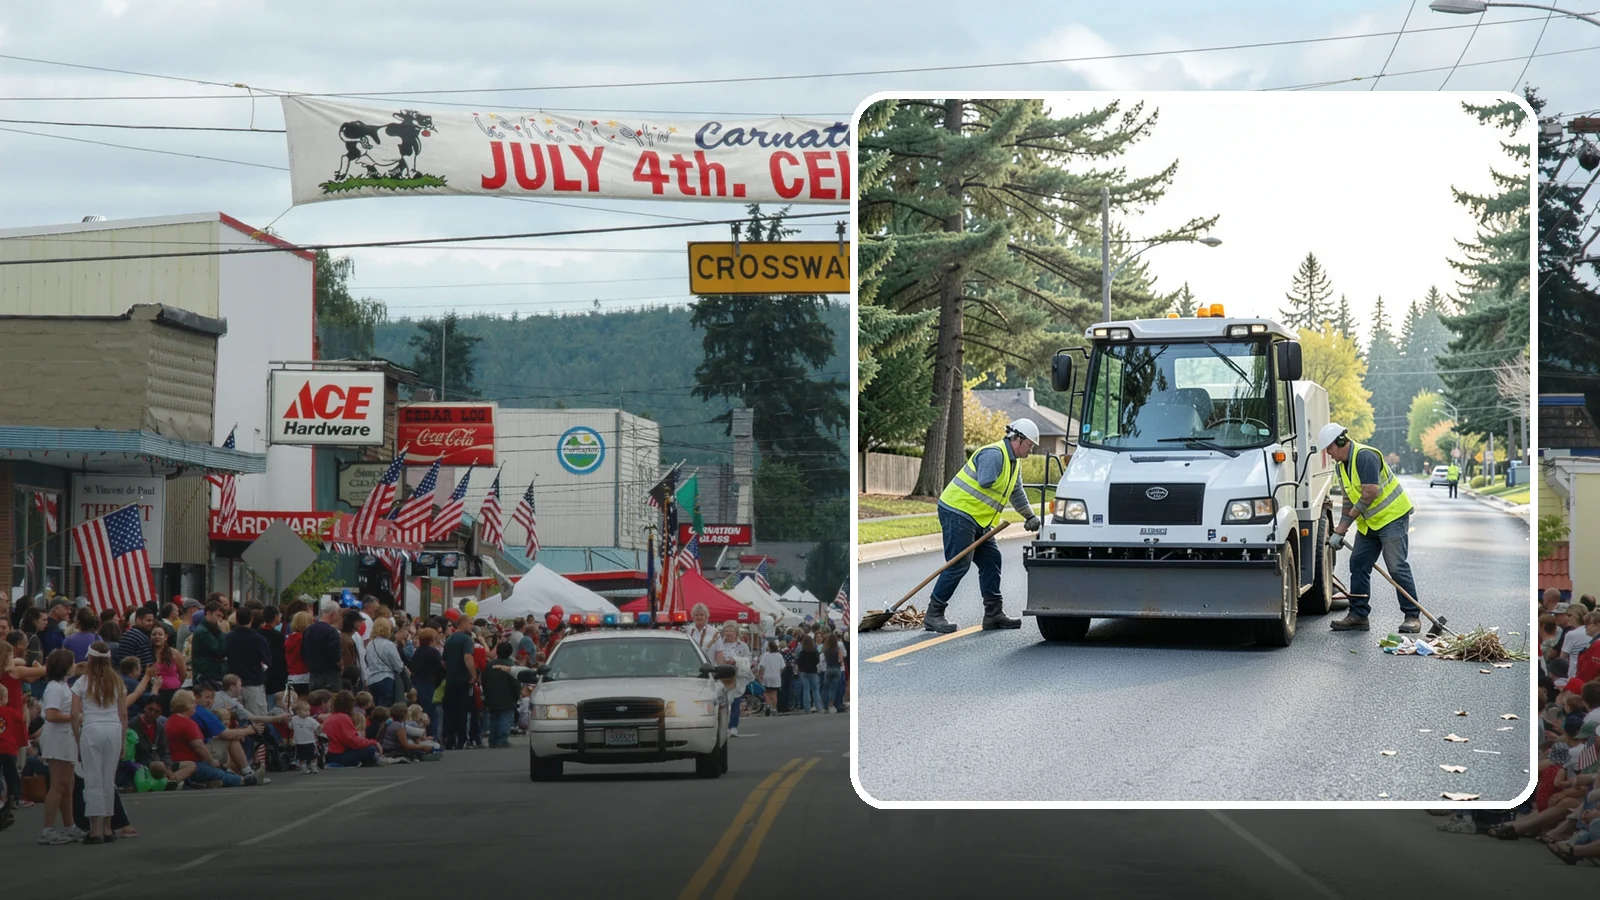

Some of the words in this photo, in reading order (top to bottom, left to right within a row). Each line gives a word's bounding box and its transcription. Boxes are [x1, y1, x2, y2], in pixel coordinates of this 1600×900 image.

[481, 141, 605, 193] JULY
[632, 150, 746, 198] 4th.
[696, 254, 850, 280] CROSSWA
[282, 380, 374, 420] ACE
[405, 409, 453, 422] CEDAR
[283, 421, 371, 436] Hardware
[416, 428, 477, 447] Coca-Cola
[353, 467, 386, 479] Simpl
[96, 485, 124, 495] Vincent
[126, 486, 136, 495] de
[137, 486, 155, 495] Paul
[688, 526, 741, 535] CRNATION
